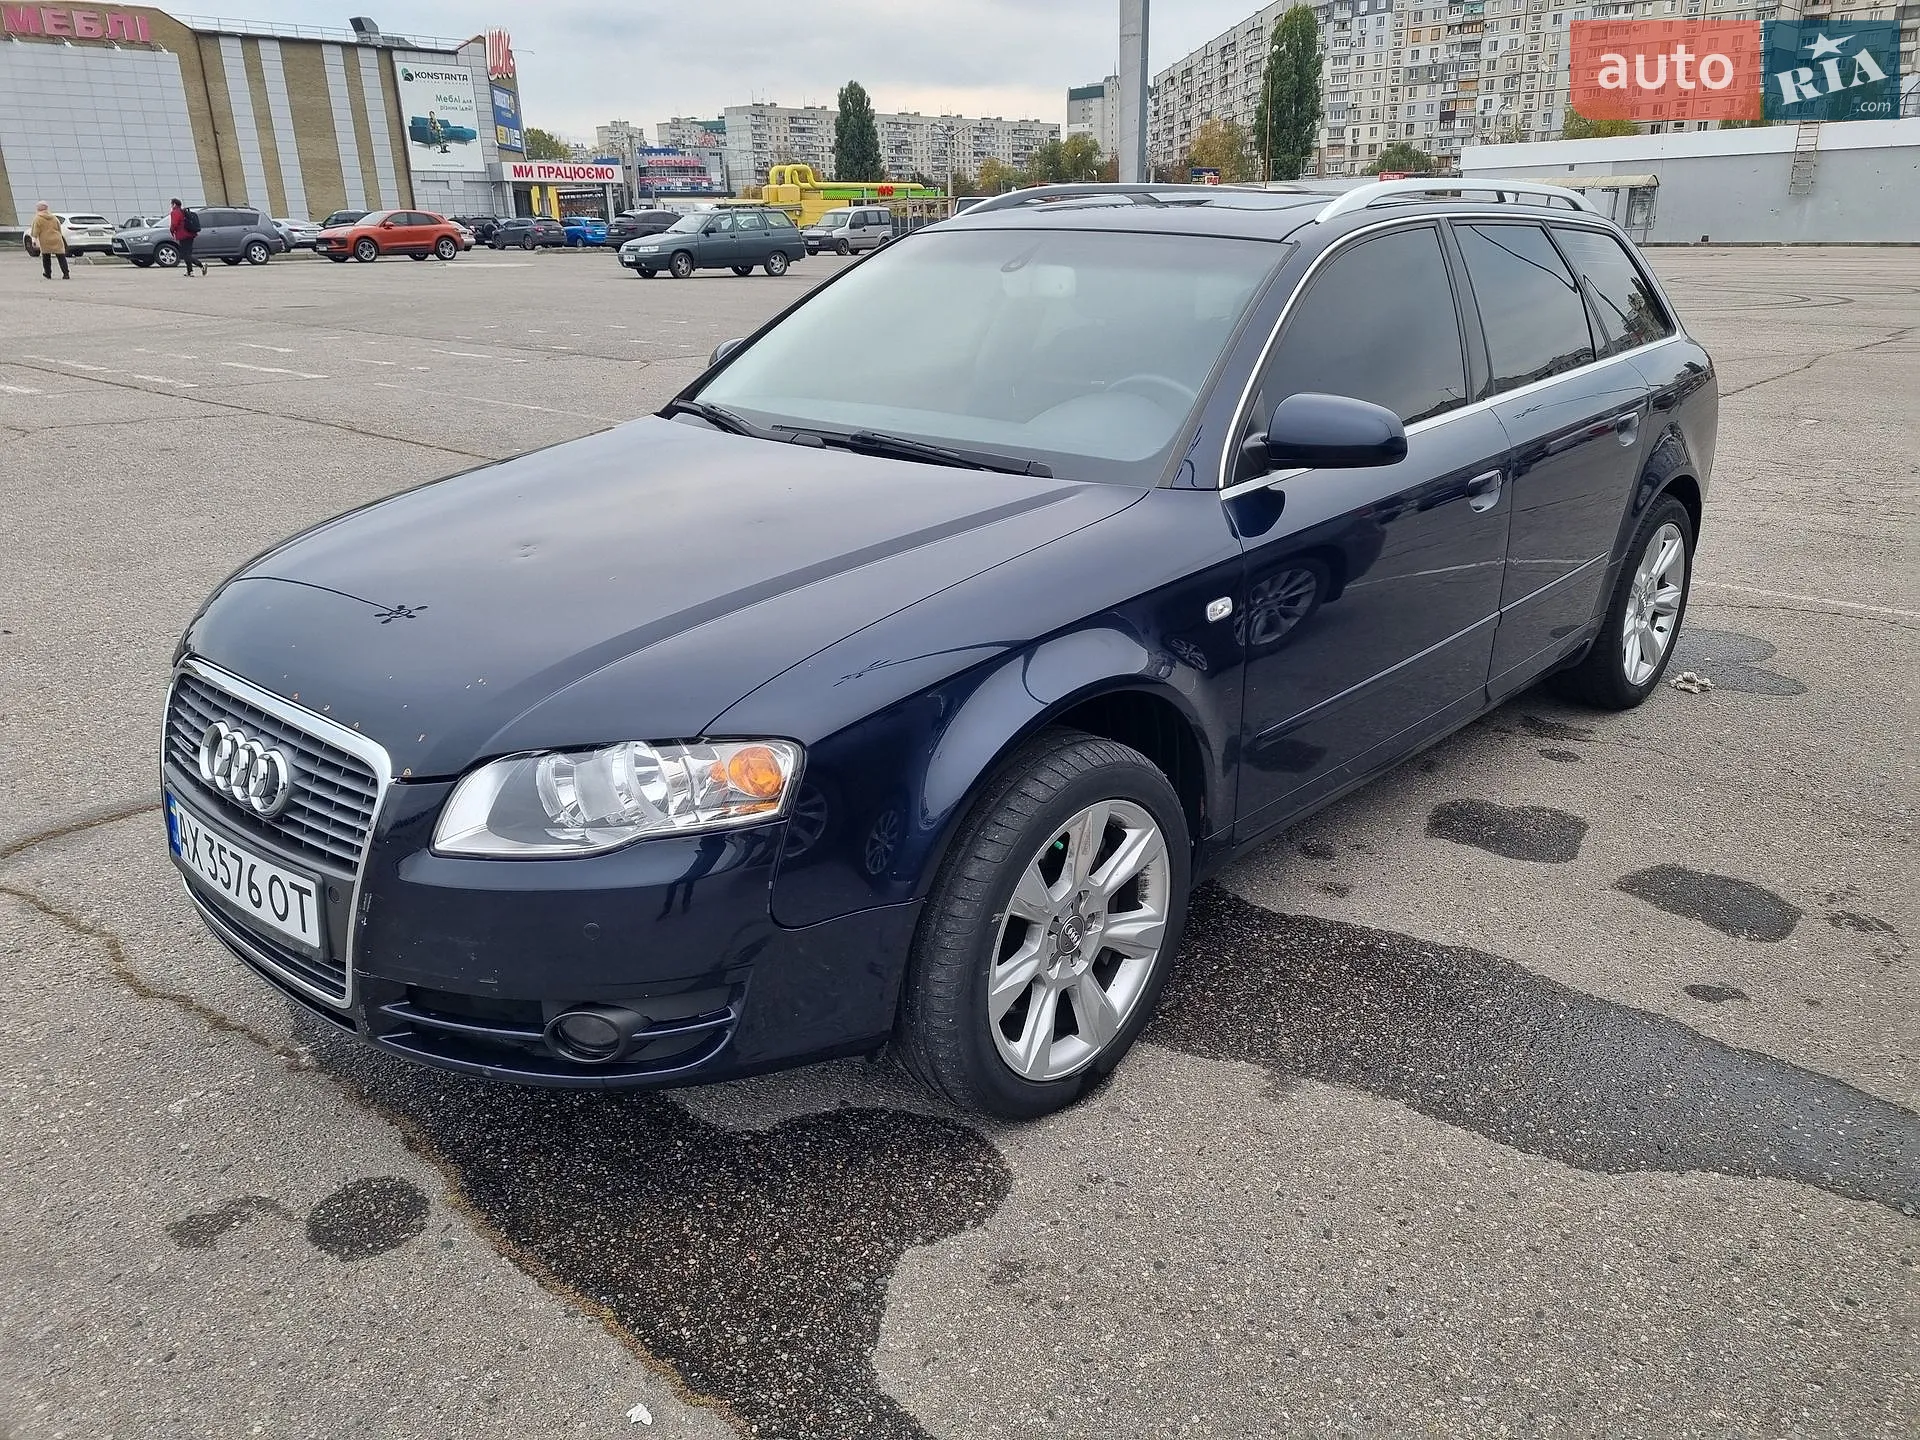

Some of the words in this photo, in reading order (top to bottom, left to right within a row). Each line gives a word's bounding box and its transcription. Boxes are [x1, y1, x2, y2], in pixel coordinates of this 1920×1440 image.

[1, 6, 150, 41] МЕБЛІ
[414, 71, 469, 82] KONSTANTA
[513, 165, 533, 178] МИ
[537, 165, 615, 181] ПРАЦЮЄМО
[204, 833, 262, 909] 3576
